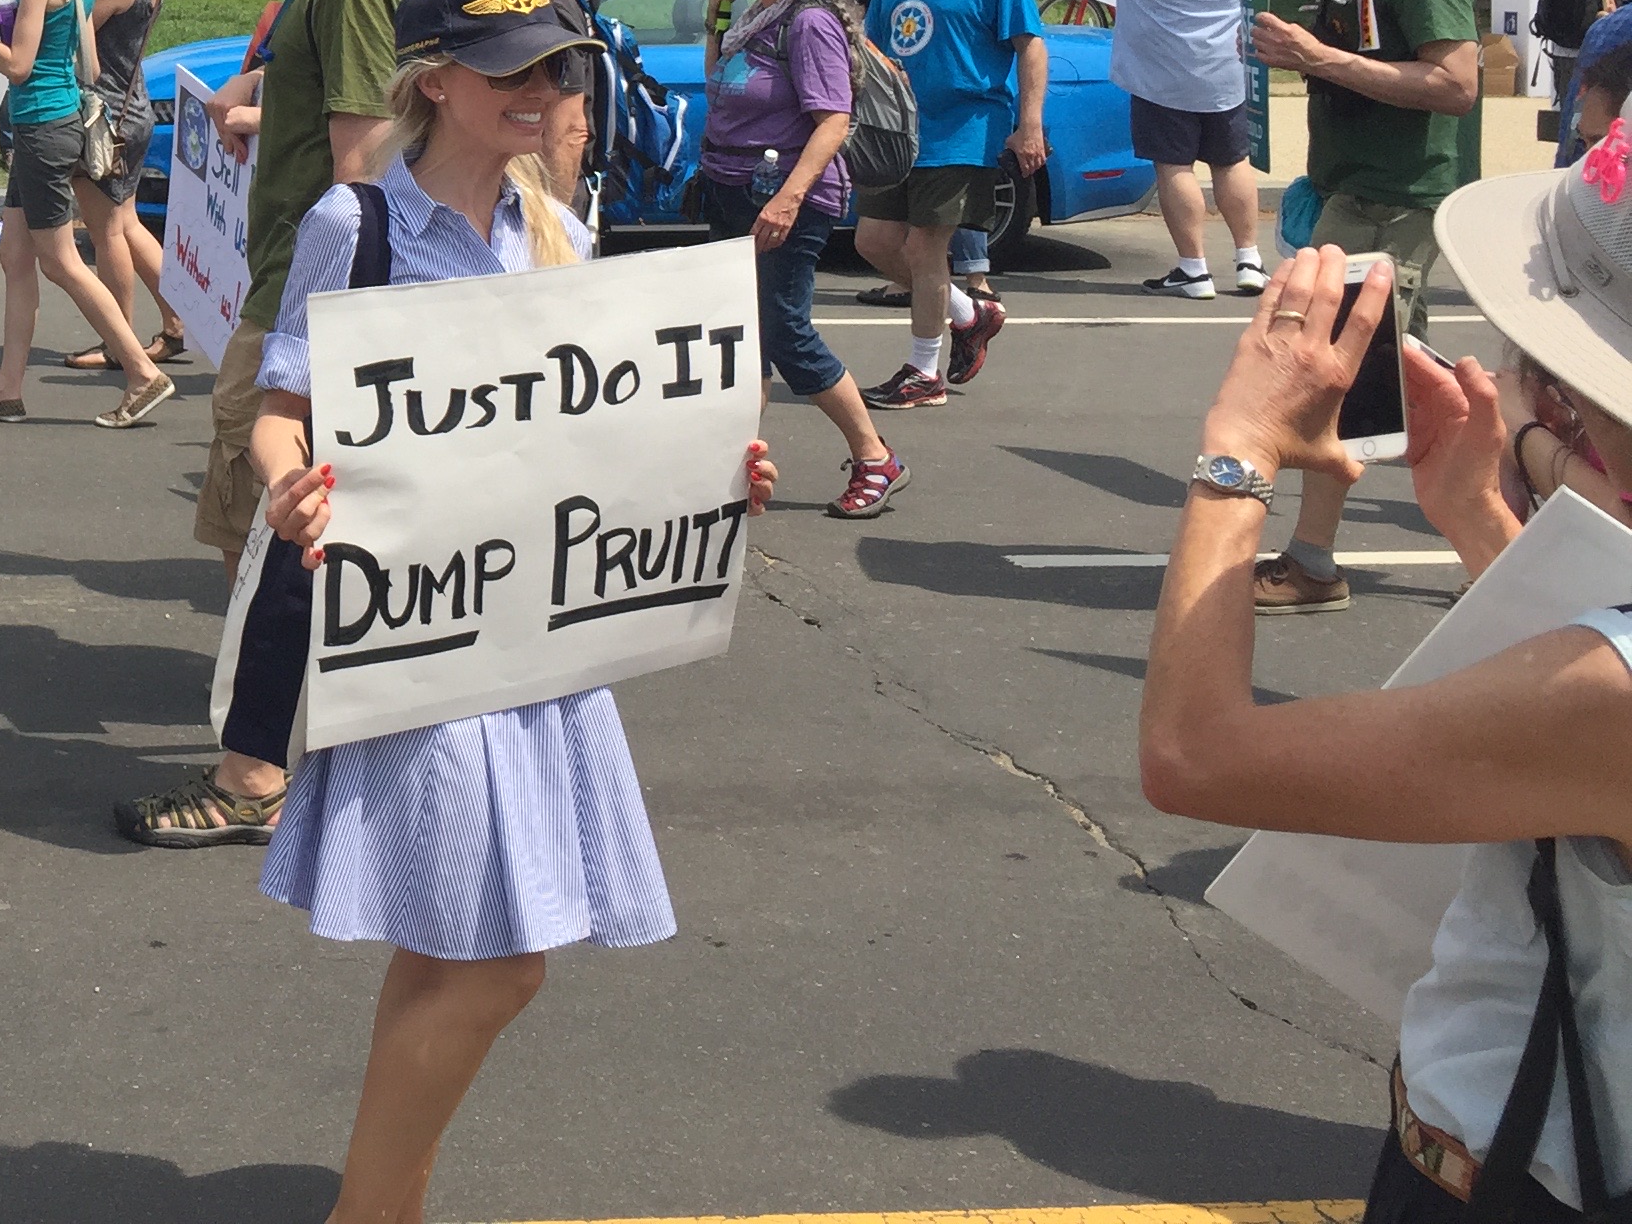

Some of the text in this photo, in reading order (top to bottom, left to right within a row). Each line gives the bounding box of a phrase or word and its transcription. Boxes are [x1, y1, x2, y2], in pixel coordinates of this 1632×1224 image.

[206, 184, 227, 237] With
[335, 357, 546, 447] JUST
[655, 324, 744, 400] IT
[322, 538, 516, 647] DUMP
[551, 495, 748, 606] PRUITT
